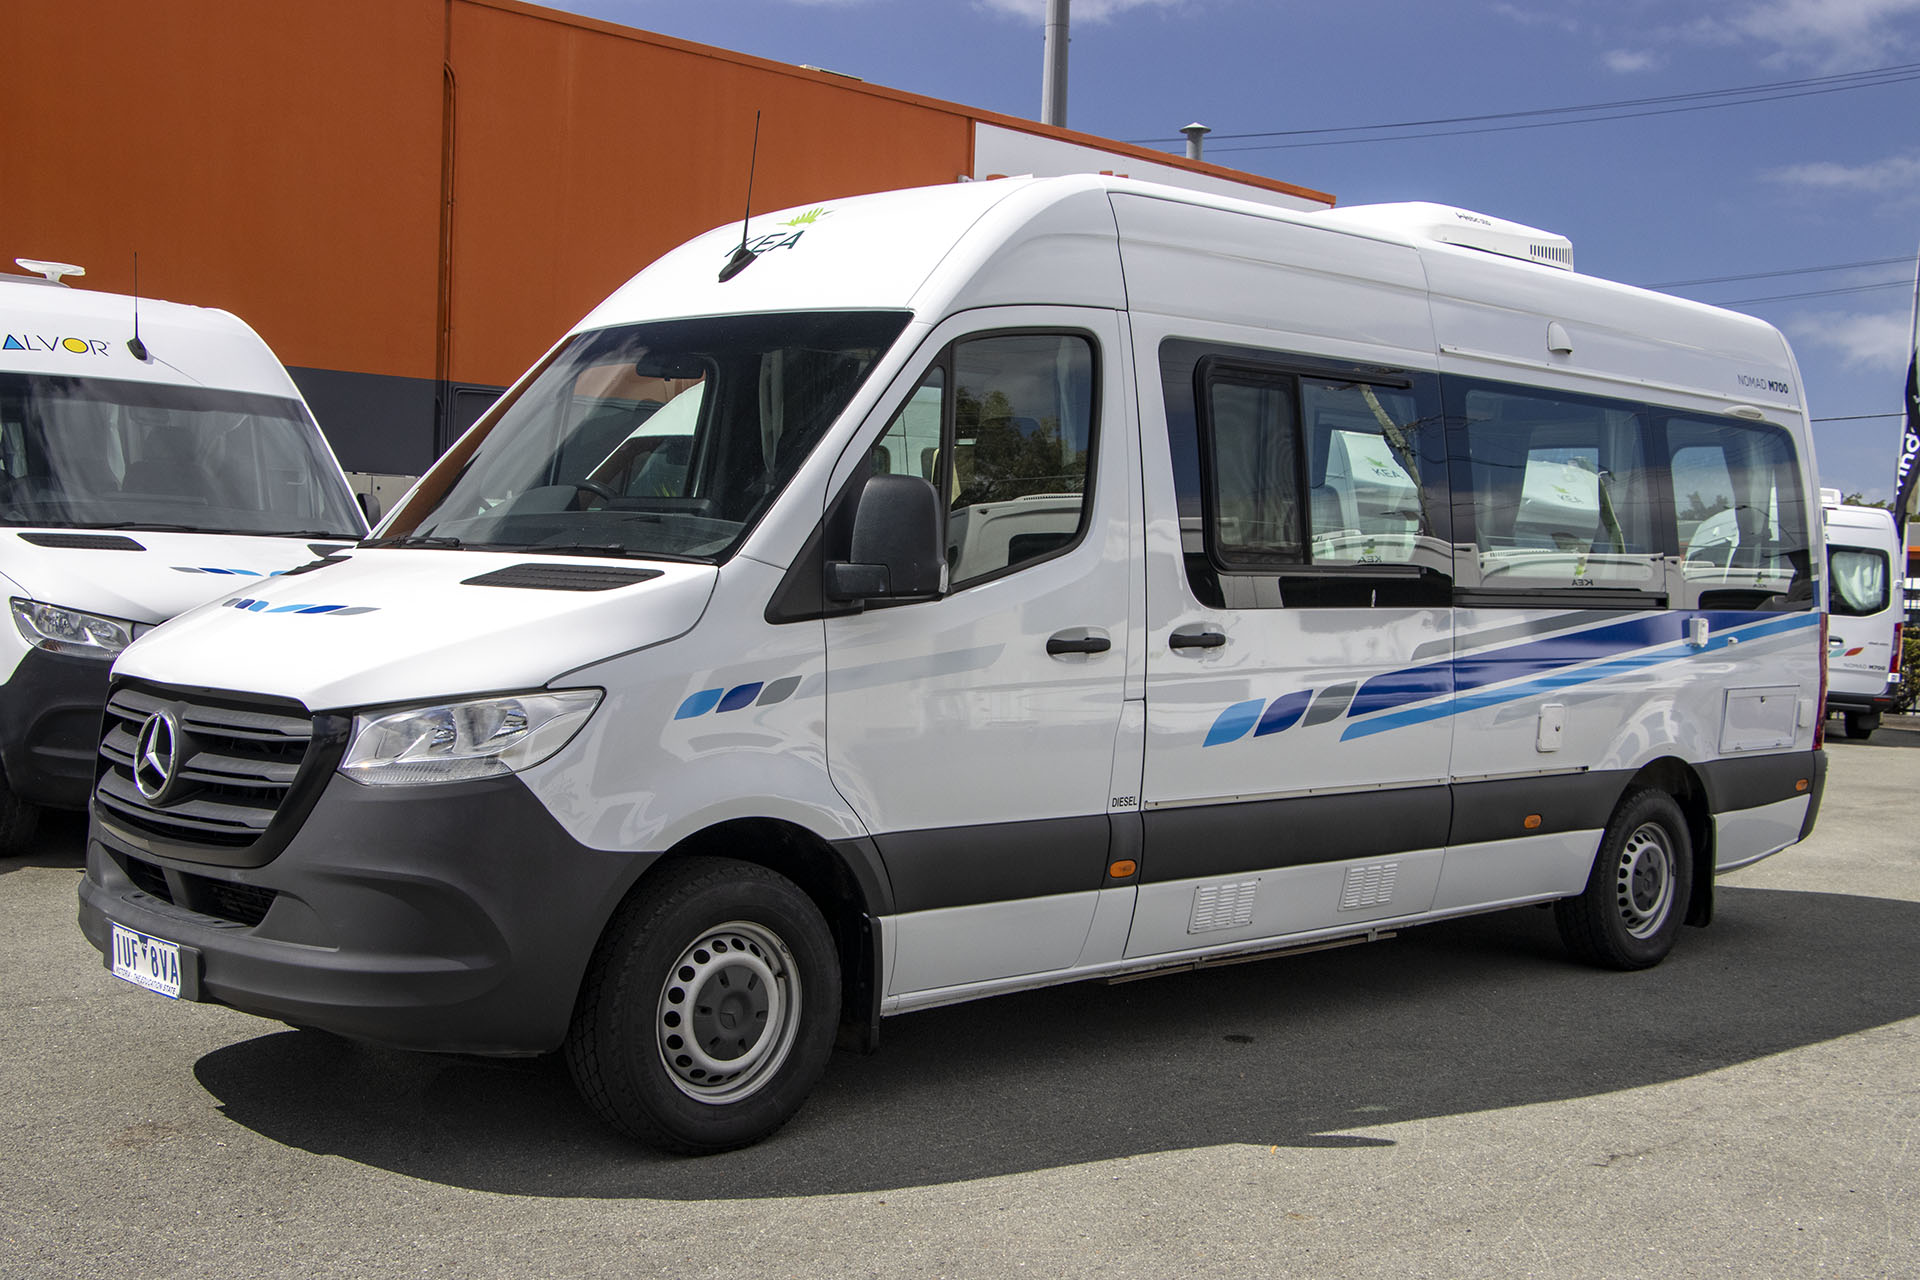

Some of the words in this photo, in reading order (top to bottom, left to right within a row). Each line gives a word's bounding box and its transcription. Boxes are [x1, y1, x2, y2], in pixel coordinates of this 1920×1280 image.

[1737, 374, 1767, 390] NOMAD
[1767, 380, 1789, 394] M700
[1111, 796, 1137, 807] DIESEL
[116, 933, 138, 970] 1UF
[150, 946, 179, 986] 8VA
